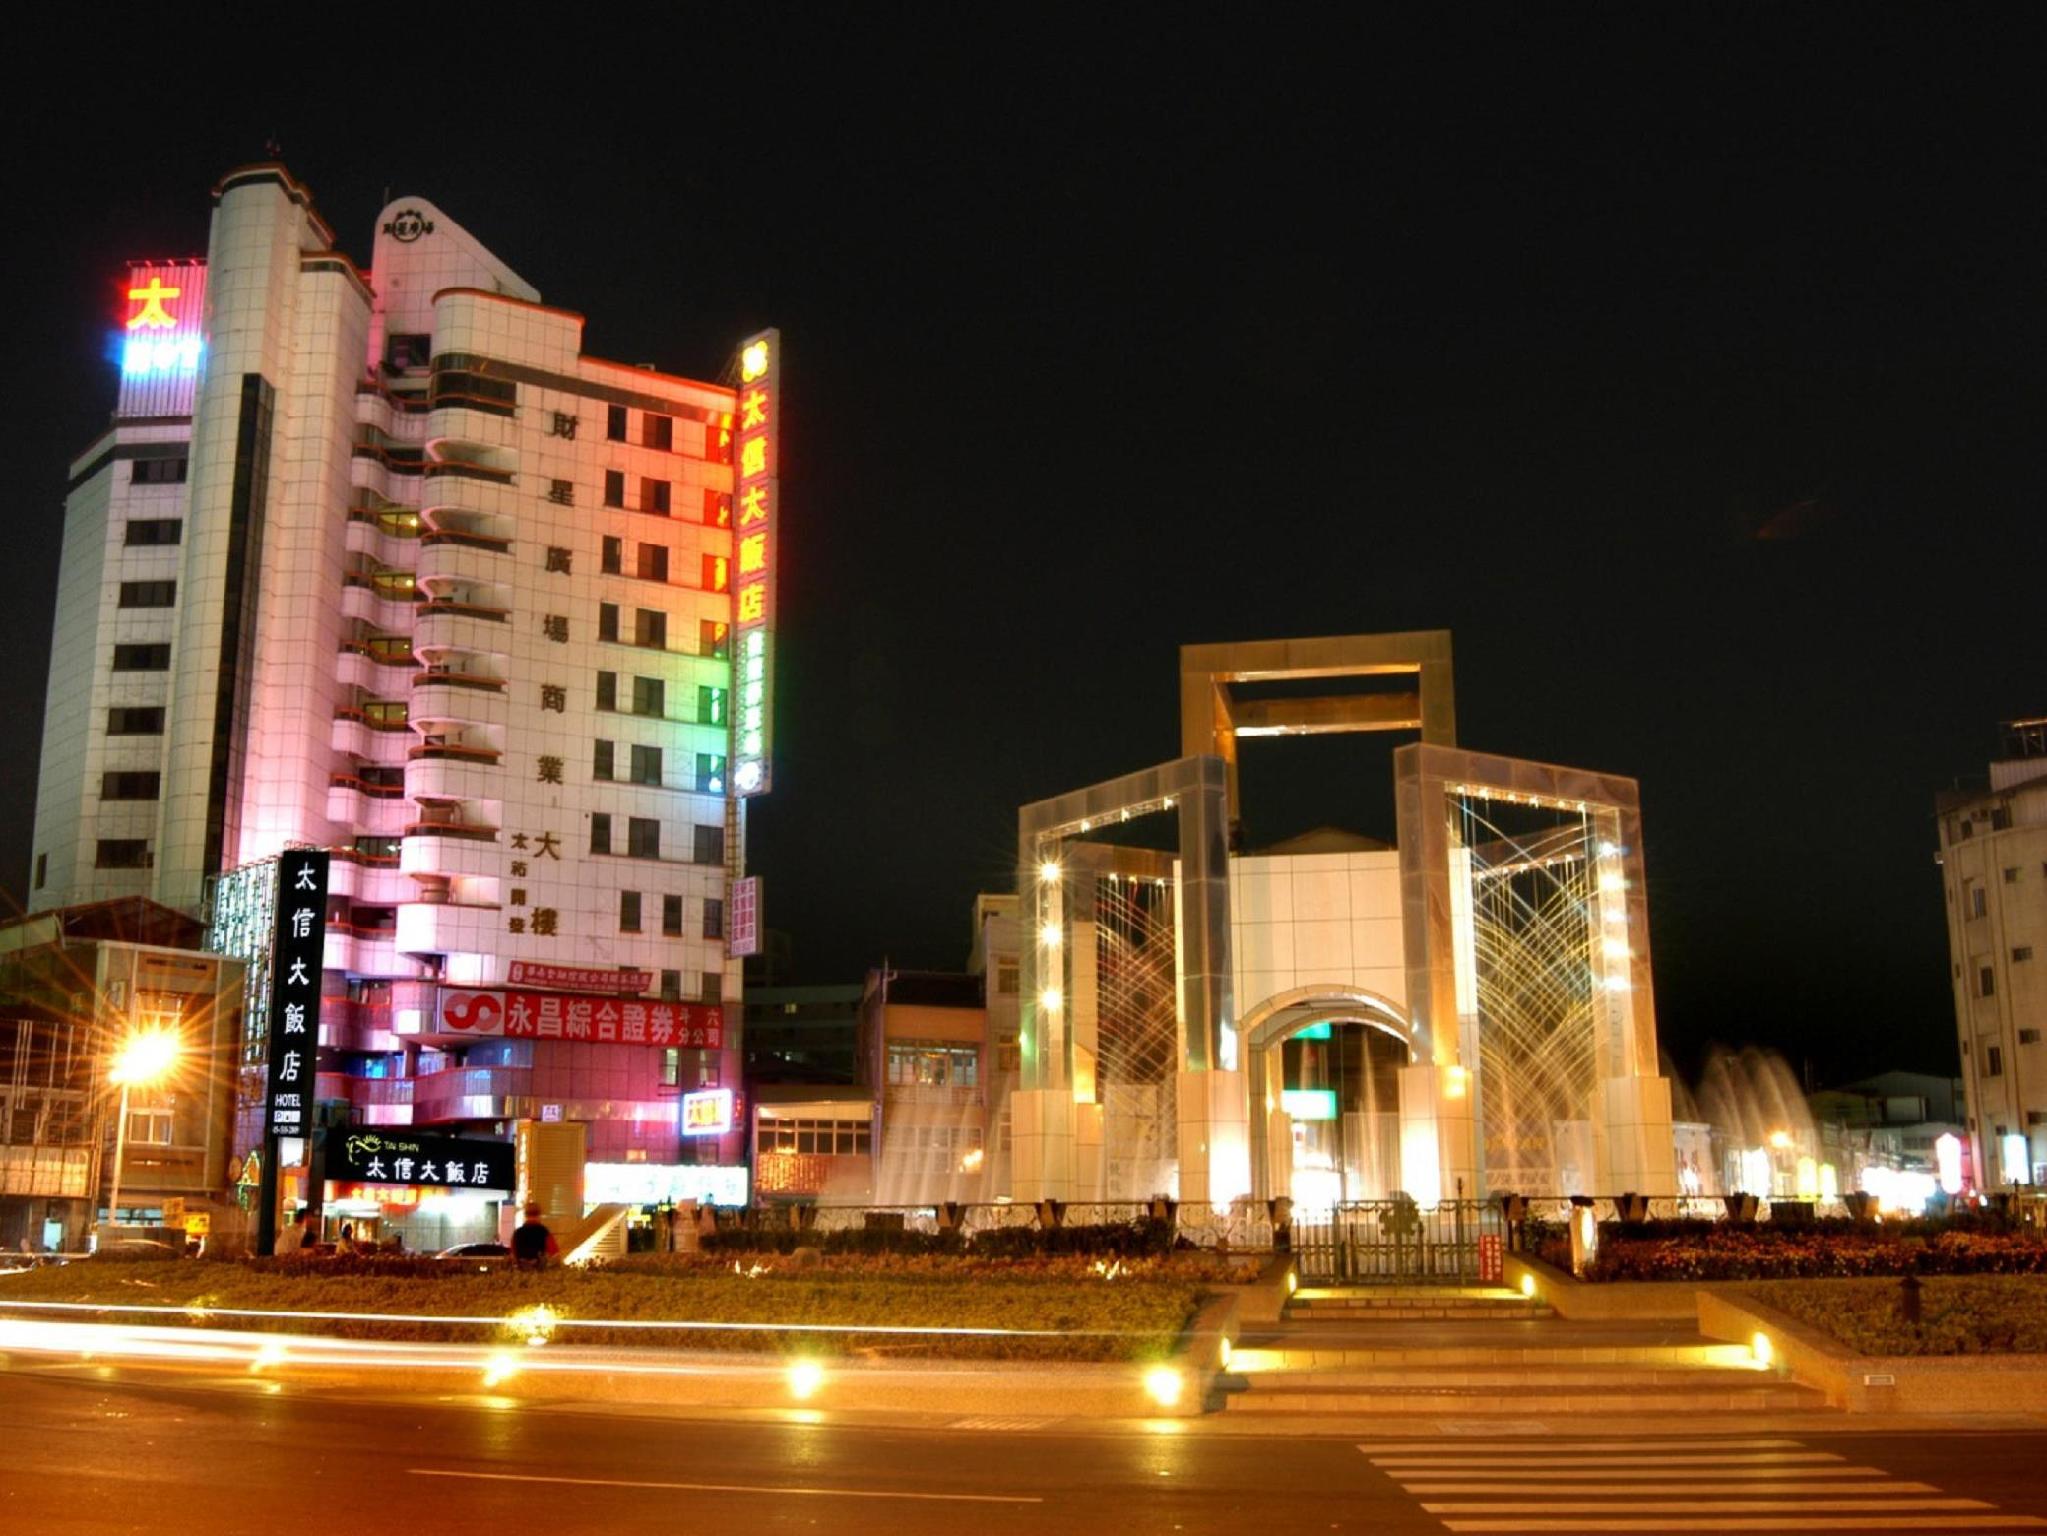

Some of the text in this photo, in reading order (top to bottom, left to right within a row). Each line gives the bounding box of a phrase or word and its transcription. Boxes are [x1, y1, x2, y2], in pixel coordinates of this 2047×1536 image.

[126, 277, 181, 330] 太
[279, 861, 317, 1082] 太信大飯店
[508, 995, 674, 1044] 永昌綜合證券
[678, 1026, 720, 1047] 分公司
[275, 1093, 301, 1107] HOTEL
[398, 1142, 420, 1153] SHIN
[366, 1155, 490, 1184] 太信大飯店
